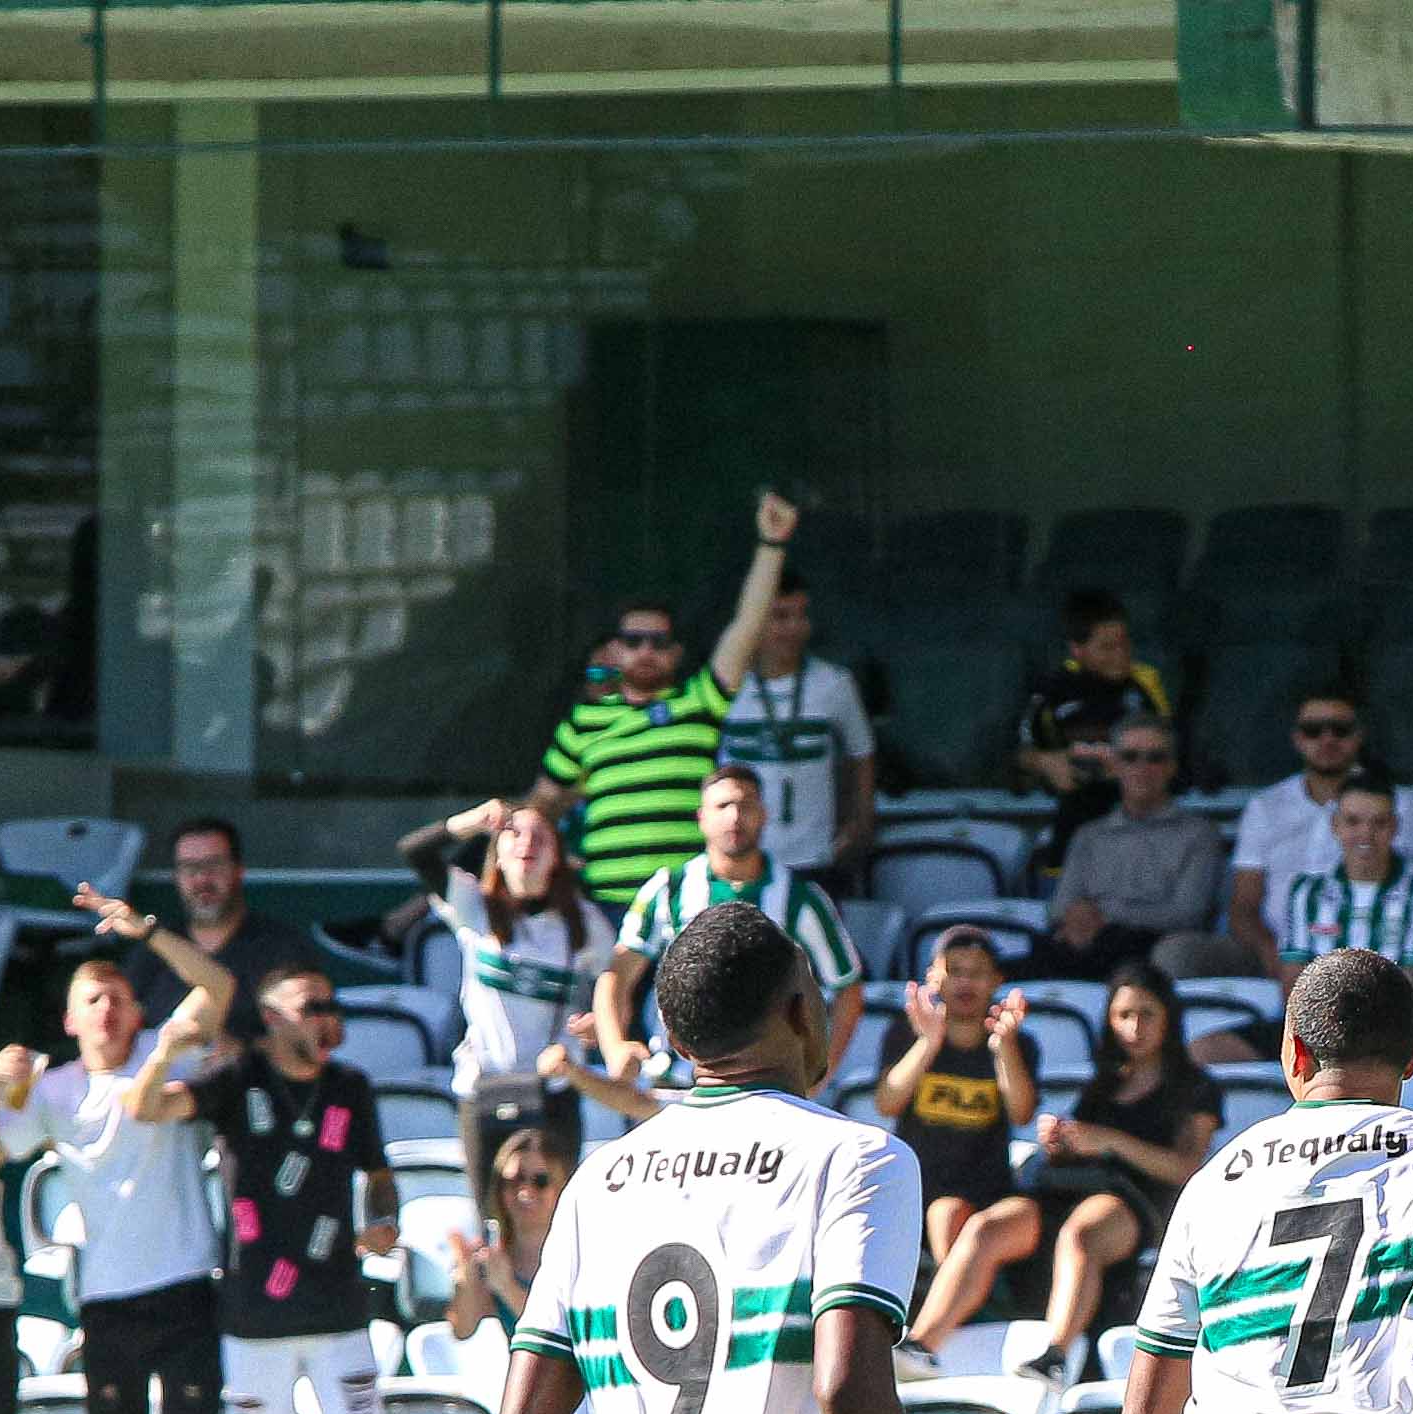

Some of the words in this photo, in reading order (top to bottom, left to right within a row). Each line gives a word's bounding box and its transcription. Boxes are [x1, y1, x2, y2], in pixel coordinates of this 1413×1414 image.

[642, 1141, 784, 1188] Tequaly
[1263, 1124, 1408, 1166] Tequaly
[1269, 1197, 1364, 1388] 7
